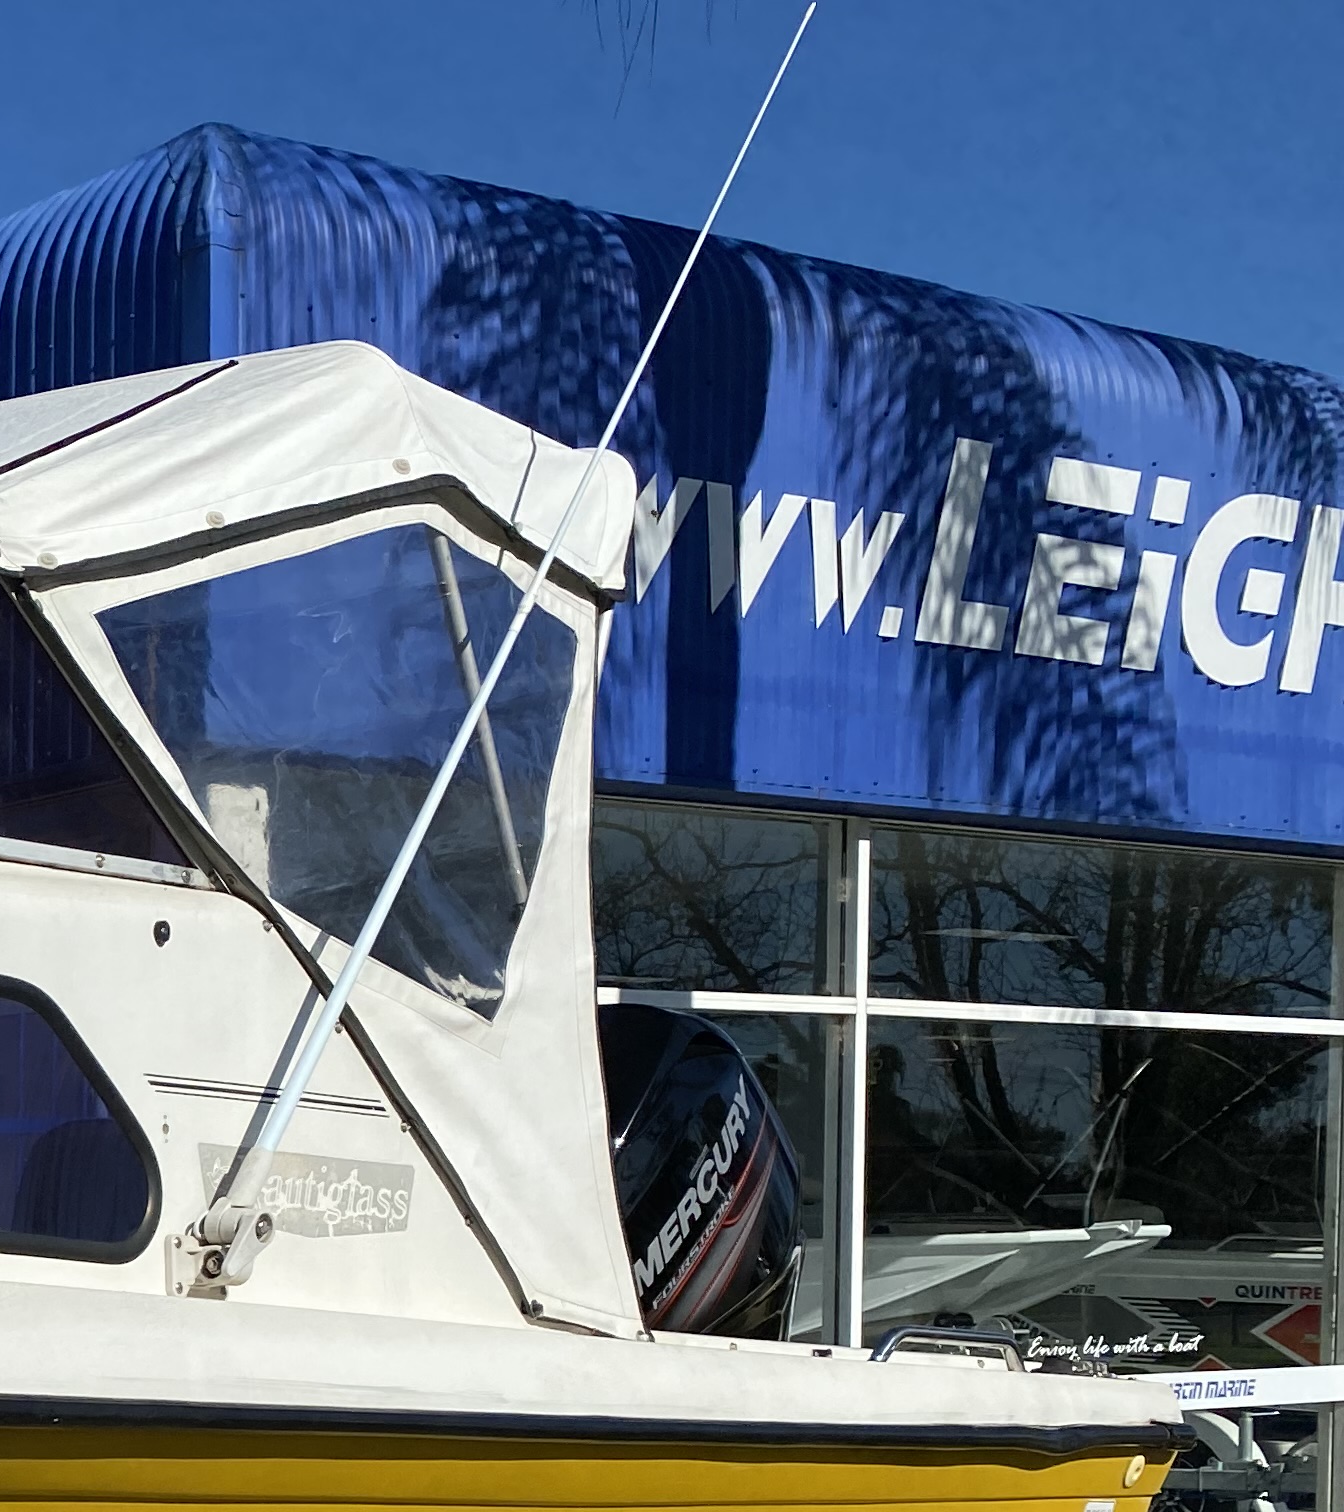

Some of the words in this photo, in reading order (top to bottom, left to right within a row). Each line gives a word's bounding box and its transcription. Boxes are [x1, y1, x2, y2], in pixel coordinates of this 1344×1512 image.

[256, 1163, 410, 1225] autiglass
[632, 1072, 750, 1296] MERCURY
[1027, 1335, 1079, 1361] Enjoy
[1083, 1335, 1111, 1358] life
[1113, 1334, 1150, 1354] with
[1152, 1343, 1164, 1353] a
[1168, 1332, 1206, 1353] boat
